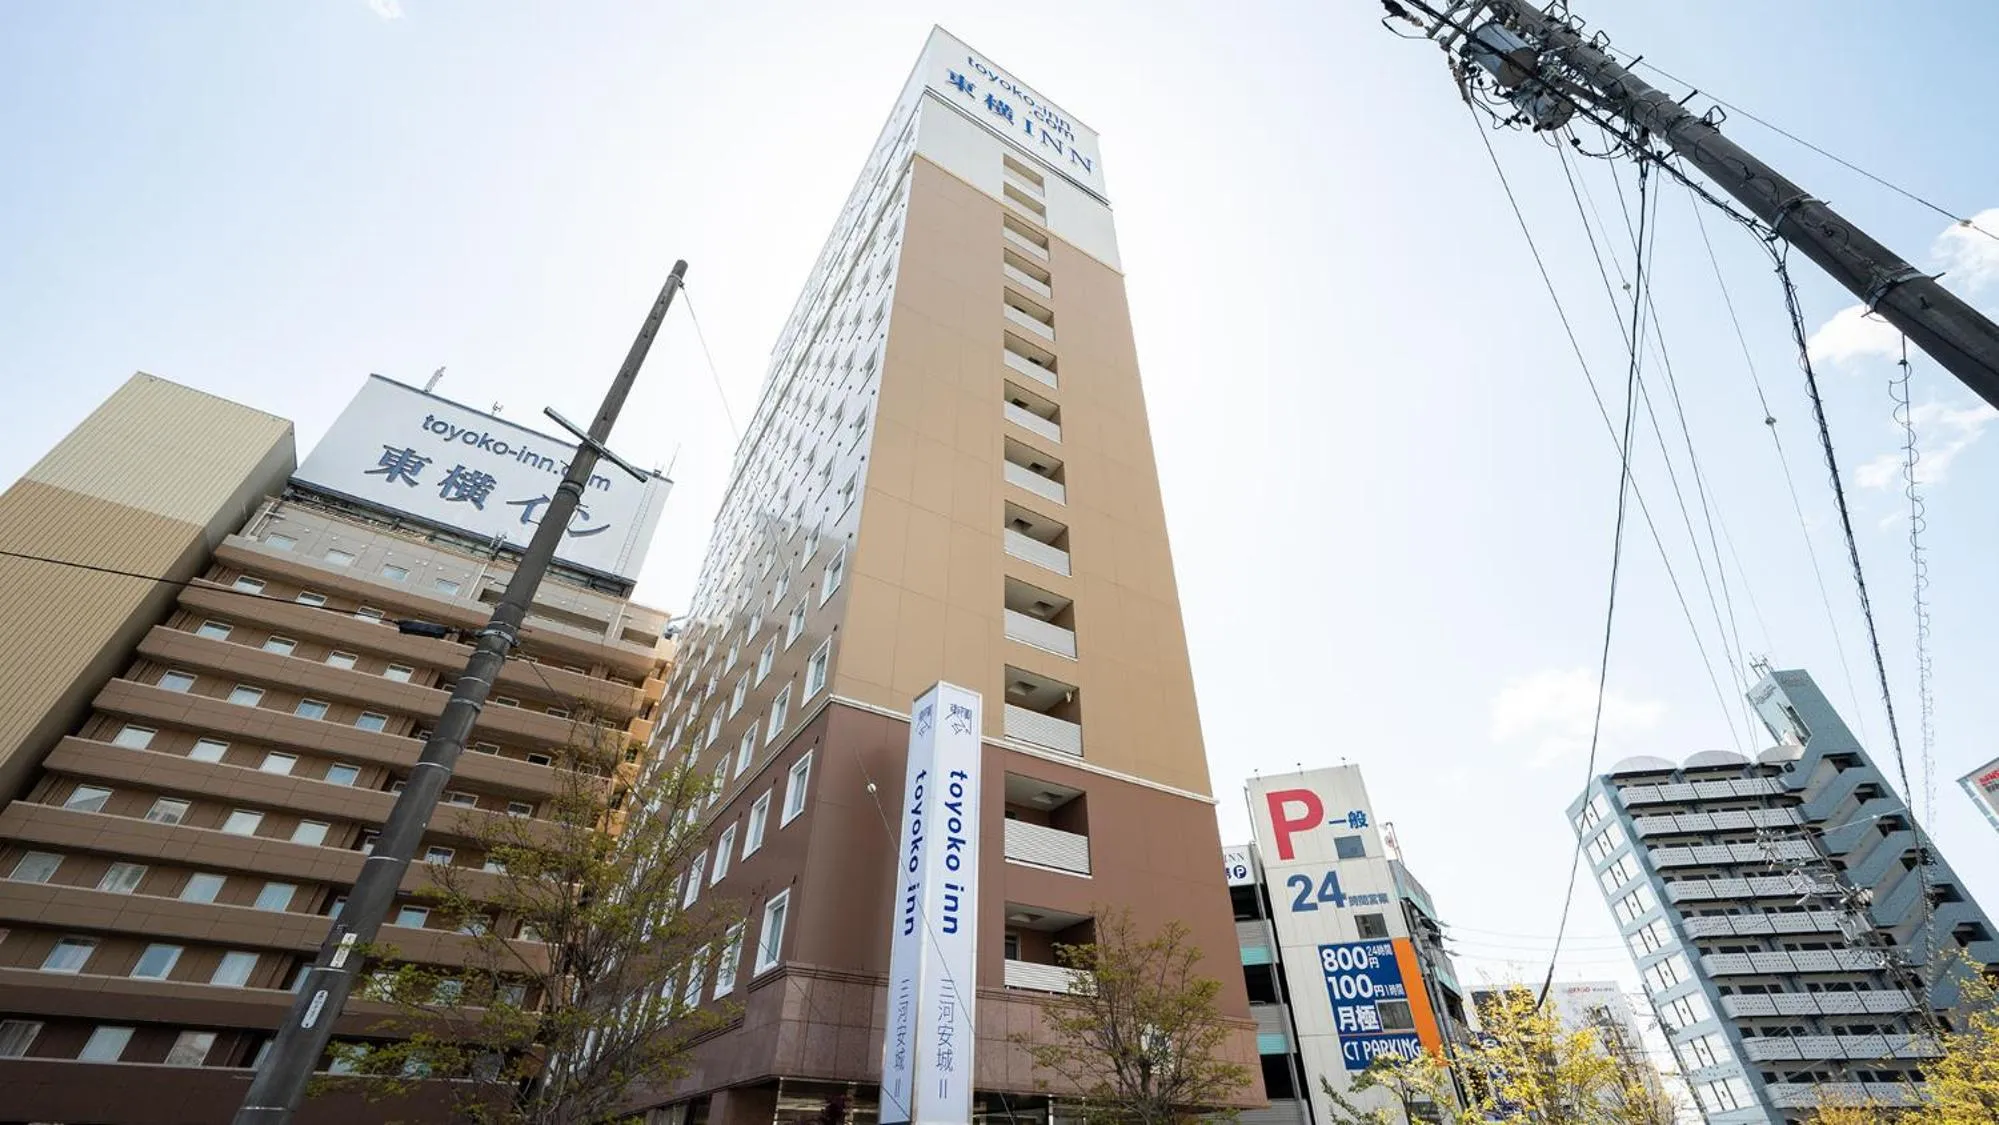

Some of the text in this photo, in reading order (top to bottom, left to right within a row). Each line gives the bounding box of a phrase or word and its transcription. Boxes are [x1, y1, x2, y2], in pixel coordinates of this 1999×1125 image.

[968, 56, 1071, 131] toyoko-inn
[1028, 110, 1075, 142] .com
[421, 413, 612, 492] toyoko-inn.cm
[904, 769, 927, 936] toyoko inn
[942, 770, 968, 934] toyoko inn
[1266, 789, 1325, 861] P
[1328, 810, 1369, 829] 一般
[1338, 1005, 1380, 1032] 月極
[1343, 1038, 1420, 1062] CT PARKING
